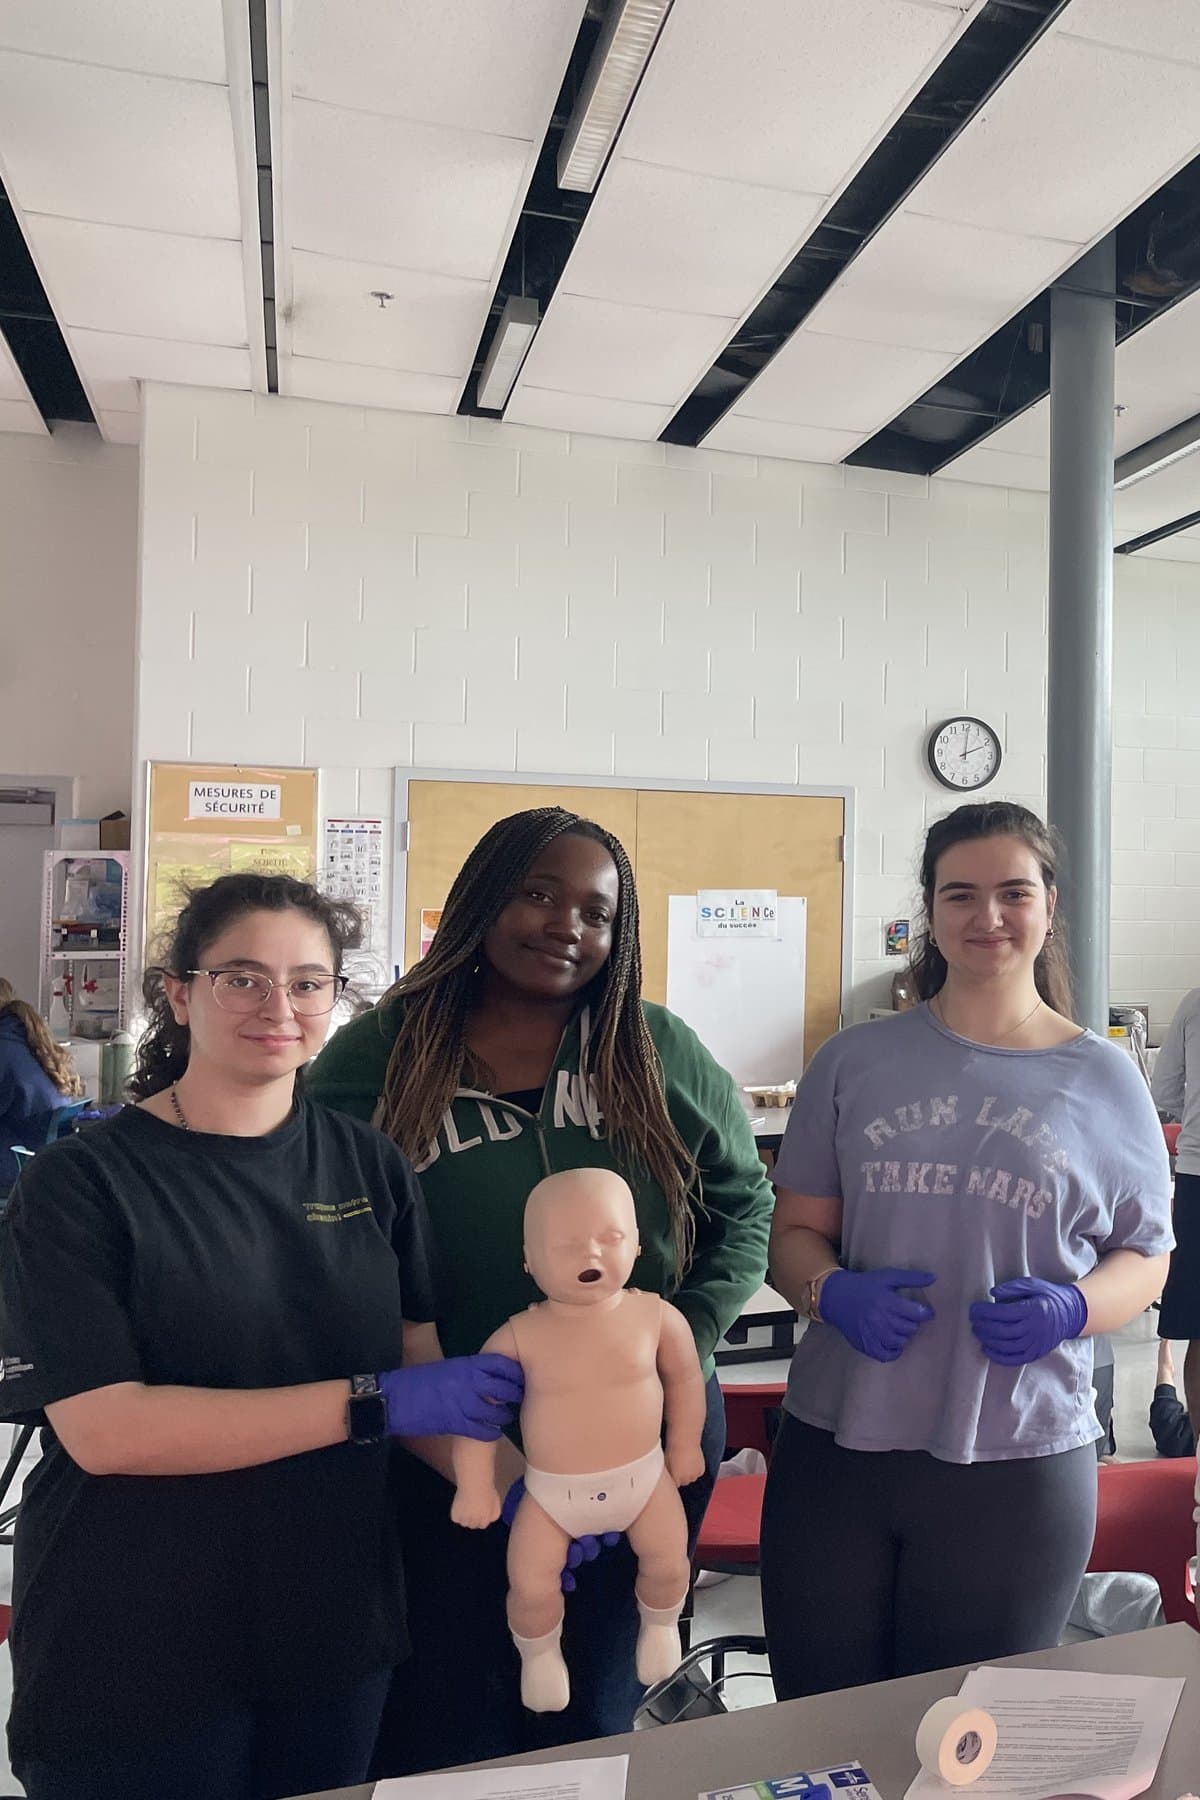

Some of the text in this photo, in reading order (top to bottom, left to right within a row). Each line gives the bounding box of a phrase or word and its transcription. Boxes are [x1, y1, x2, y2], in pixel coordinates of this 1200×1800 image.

[950, 726, 957, 734] 11
[940, 736, 949, 744] 10
[984, 738, 990, 746] 2
[937, 749, 943, 757] 9
[987, 752, 992, 760] 3
[940, 762, 946, 770] 8
[984, 764, 990, 772] 4
[962, 776, 968, 784] 6
[974, 774, 980, 782] 5
[194, 787, 277, 800] MESURES DE
[205, 801, 264, 814] SÉCURITÉ
[864, 1095, 1067, 1174] RUN LAPS
[861, 1161, 1053, 1219] TAKE NAPS
